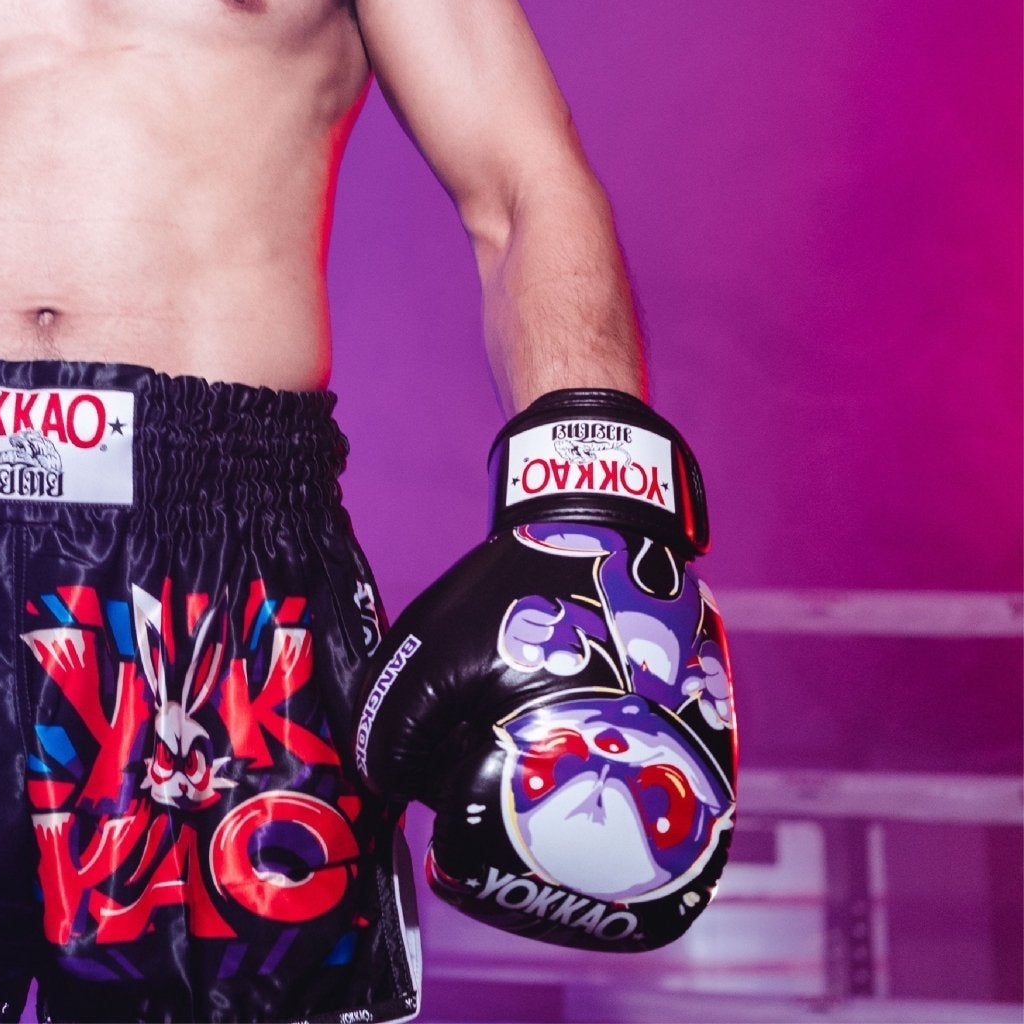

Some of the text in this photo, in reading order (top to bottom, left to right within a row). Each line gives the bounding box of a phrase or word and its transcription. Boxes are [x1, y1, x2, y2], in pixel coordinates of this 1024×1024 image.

[521, 458, 665, 505] YOKKAO
[356, 634, 422, 777] BANGKOK
[477, 867, 638, 941] YOKKAO
